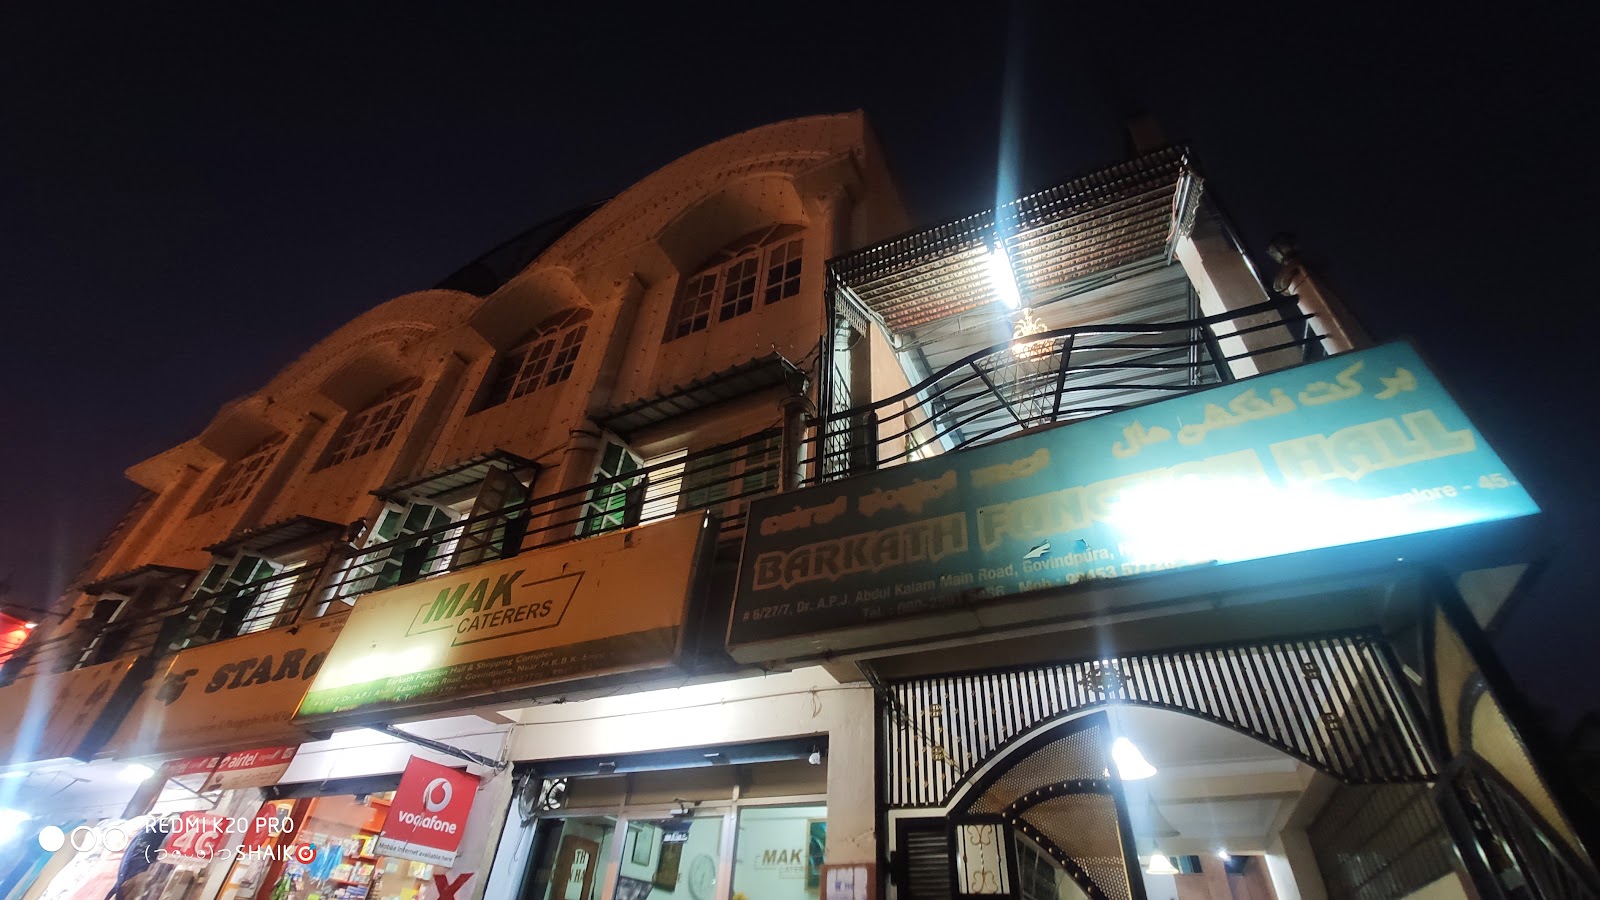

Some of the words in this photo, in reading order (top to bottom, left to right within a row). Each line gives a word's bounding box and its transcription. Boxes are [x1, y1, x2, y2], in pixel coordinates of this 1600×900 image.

[753, 511, 968, 591] BARKATH
[1270, 409, 1476, 481] HALL
[855, 586, 890, 602] Abdul
[894, 578, 936, 595] Kalam
[940, 572, 973, 588] Main
[978, 563, 1018, 580] Road,
[1022, 546, 1115, 573] Govindpura,
[422, 568, 527, 624] MAK
[456, 599, 554, 635] CATERERS
[205, 648, 308, 694] STAR
[396, 684, 420, 693] Kalam
[421, 680, 439, 688] Main
[516, 663, 538, 673] Near
[415, 669, 448, 682] Function
[450, 665, 466, 675] Hall
[476, 658, 514, 671] Shopping
[515, 650, 554, 664] Complex
[228, 752, 259, 768] airtel
[398, 810, 457, 835] vodafone
[172, 829, 219, 856] 4G
[379, 842, 397, 851] Mobile
[419, 851, 441, 861] available
[442, 855, 452, 863] here
[762, 849, 803, 866] MAK
